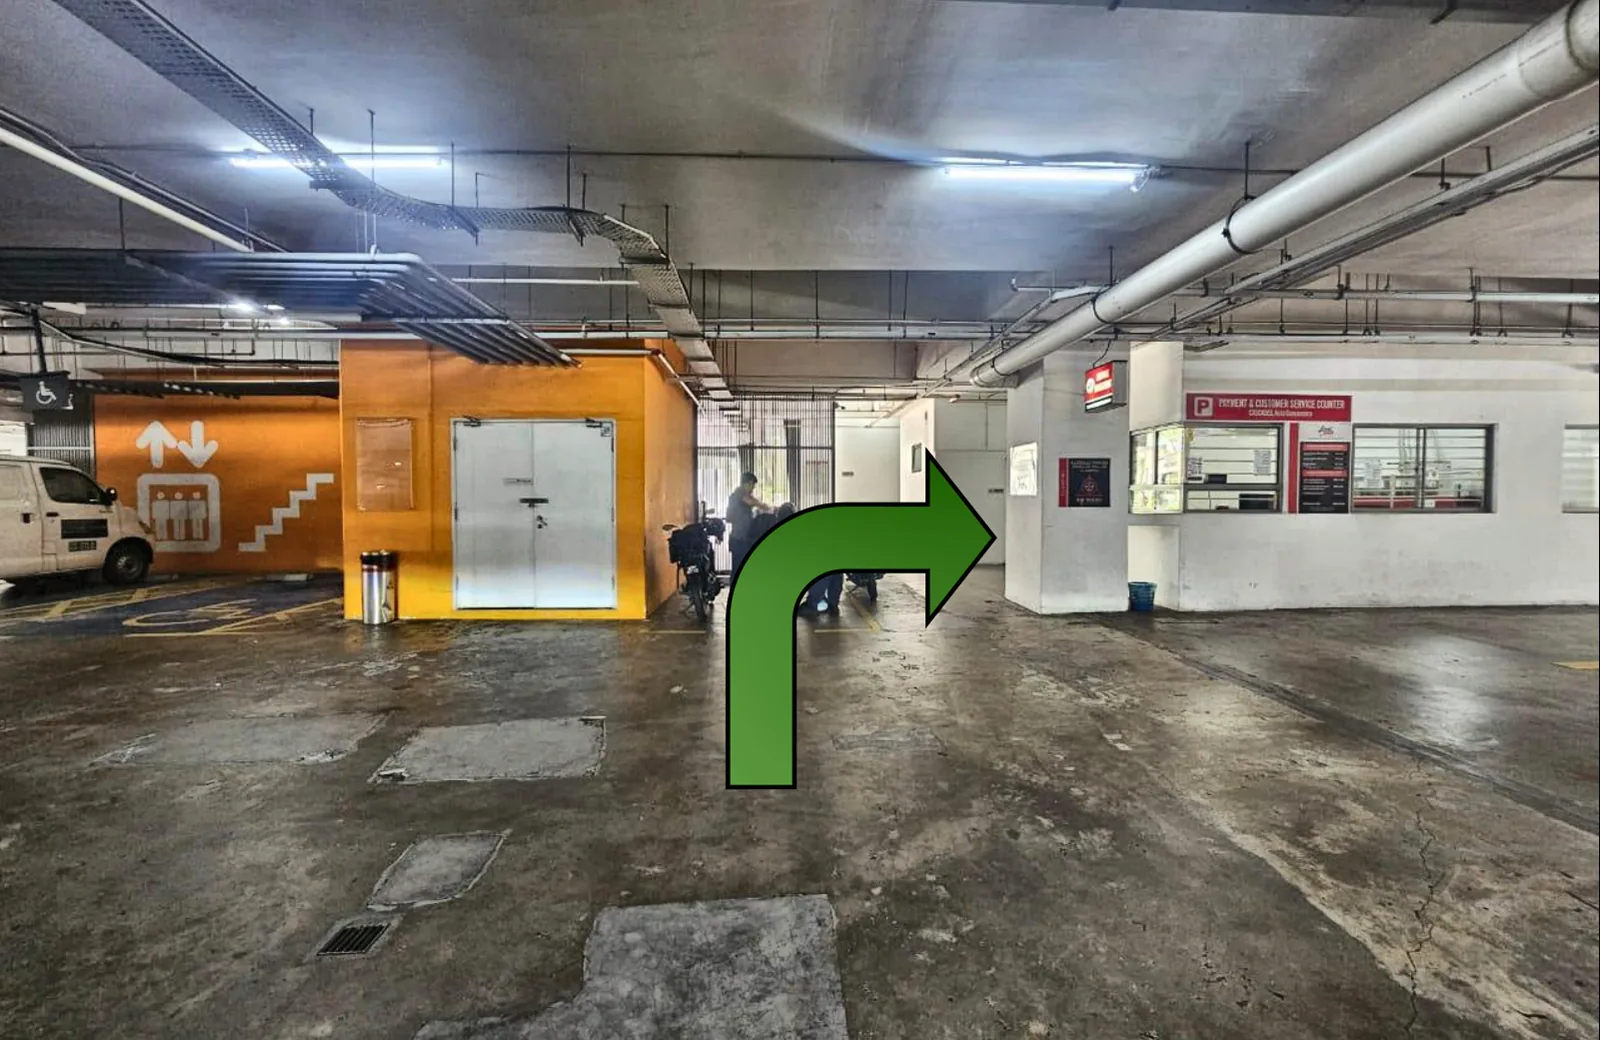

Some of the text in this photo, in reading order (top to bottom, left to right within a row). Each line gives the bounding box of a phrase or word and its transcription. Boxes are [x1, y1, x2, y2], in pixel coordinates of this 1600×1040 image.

[1196, 399, 1210, 414] P
[1218, 398, 1248, 408] PAYMENT
[1255, 399, 1289, 408] CUSTOMER
[1290, 399, 1316, 409] SERVICE
[1316, 399, 1345, 409] COUNTER
